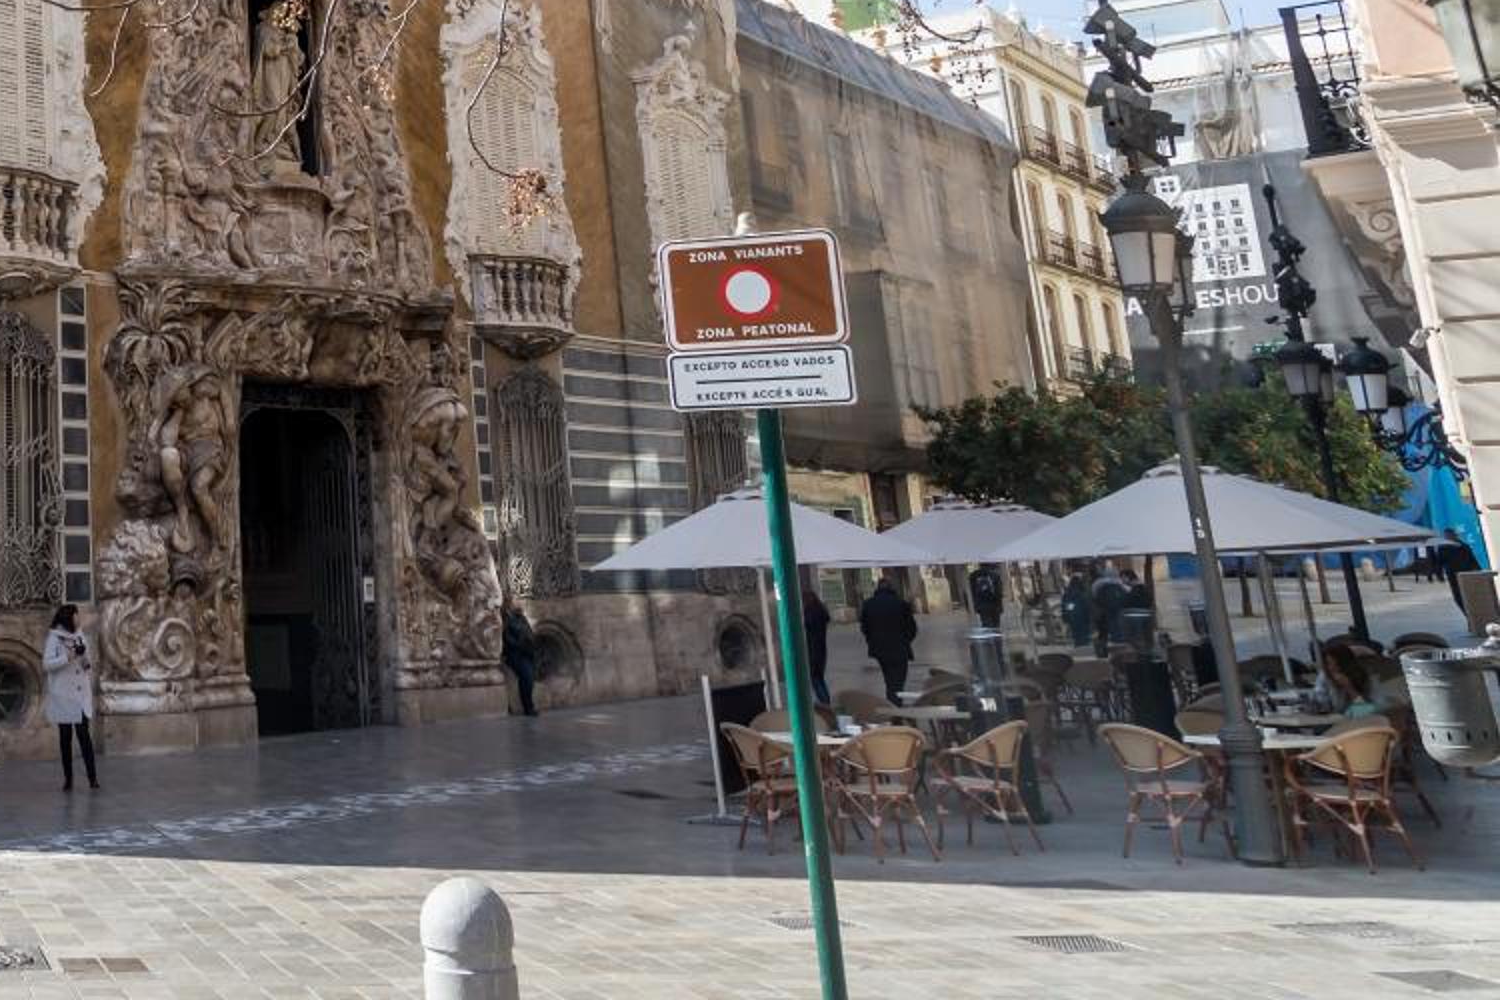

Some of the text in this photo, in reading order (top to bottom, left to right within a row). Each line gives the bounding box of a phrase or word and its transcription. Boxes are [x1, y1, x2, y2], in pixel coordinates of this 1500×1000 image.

[688, 244, 804, 264] ZONA VIANANTS
[696, 322, 816, 339] ZONA PEATONAL
[684, 355, 836, 373] EXCEPTO ACCESO VADOS
[696, 391, 747, 402] EXCEPTE
